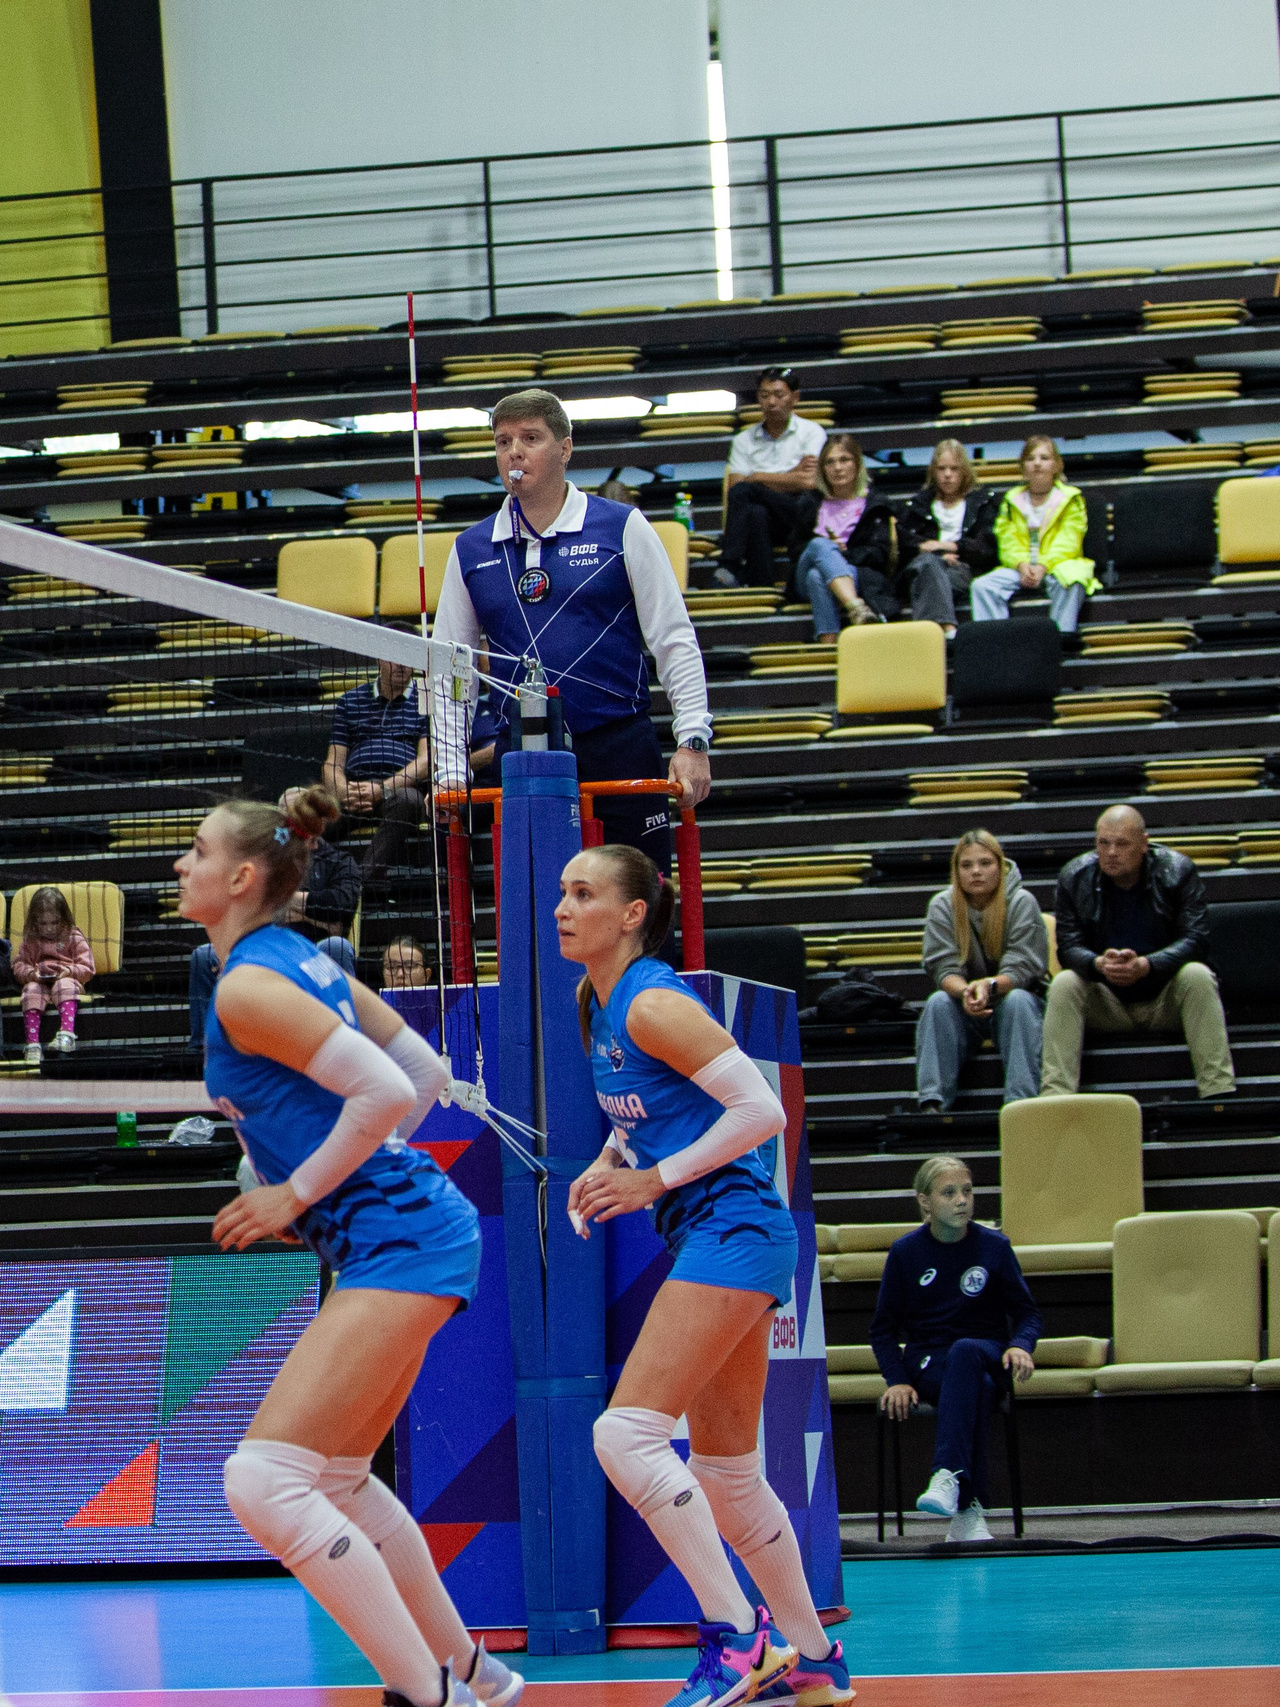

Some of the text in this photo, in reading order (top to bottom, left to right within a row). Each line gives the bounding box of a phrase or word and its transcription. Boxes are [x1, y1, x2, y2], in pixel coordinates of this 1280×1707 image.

[569, 544, 598, 556] ВФВ
[568, 558, 599, 567] СУДЬЯ
[773, 1316, 796, 1349] ВФВ
